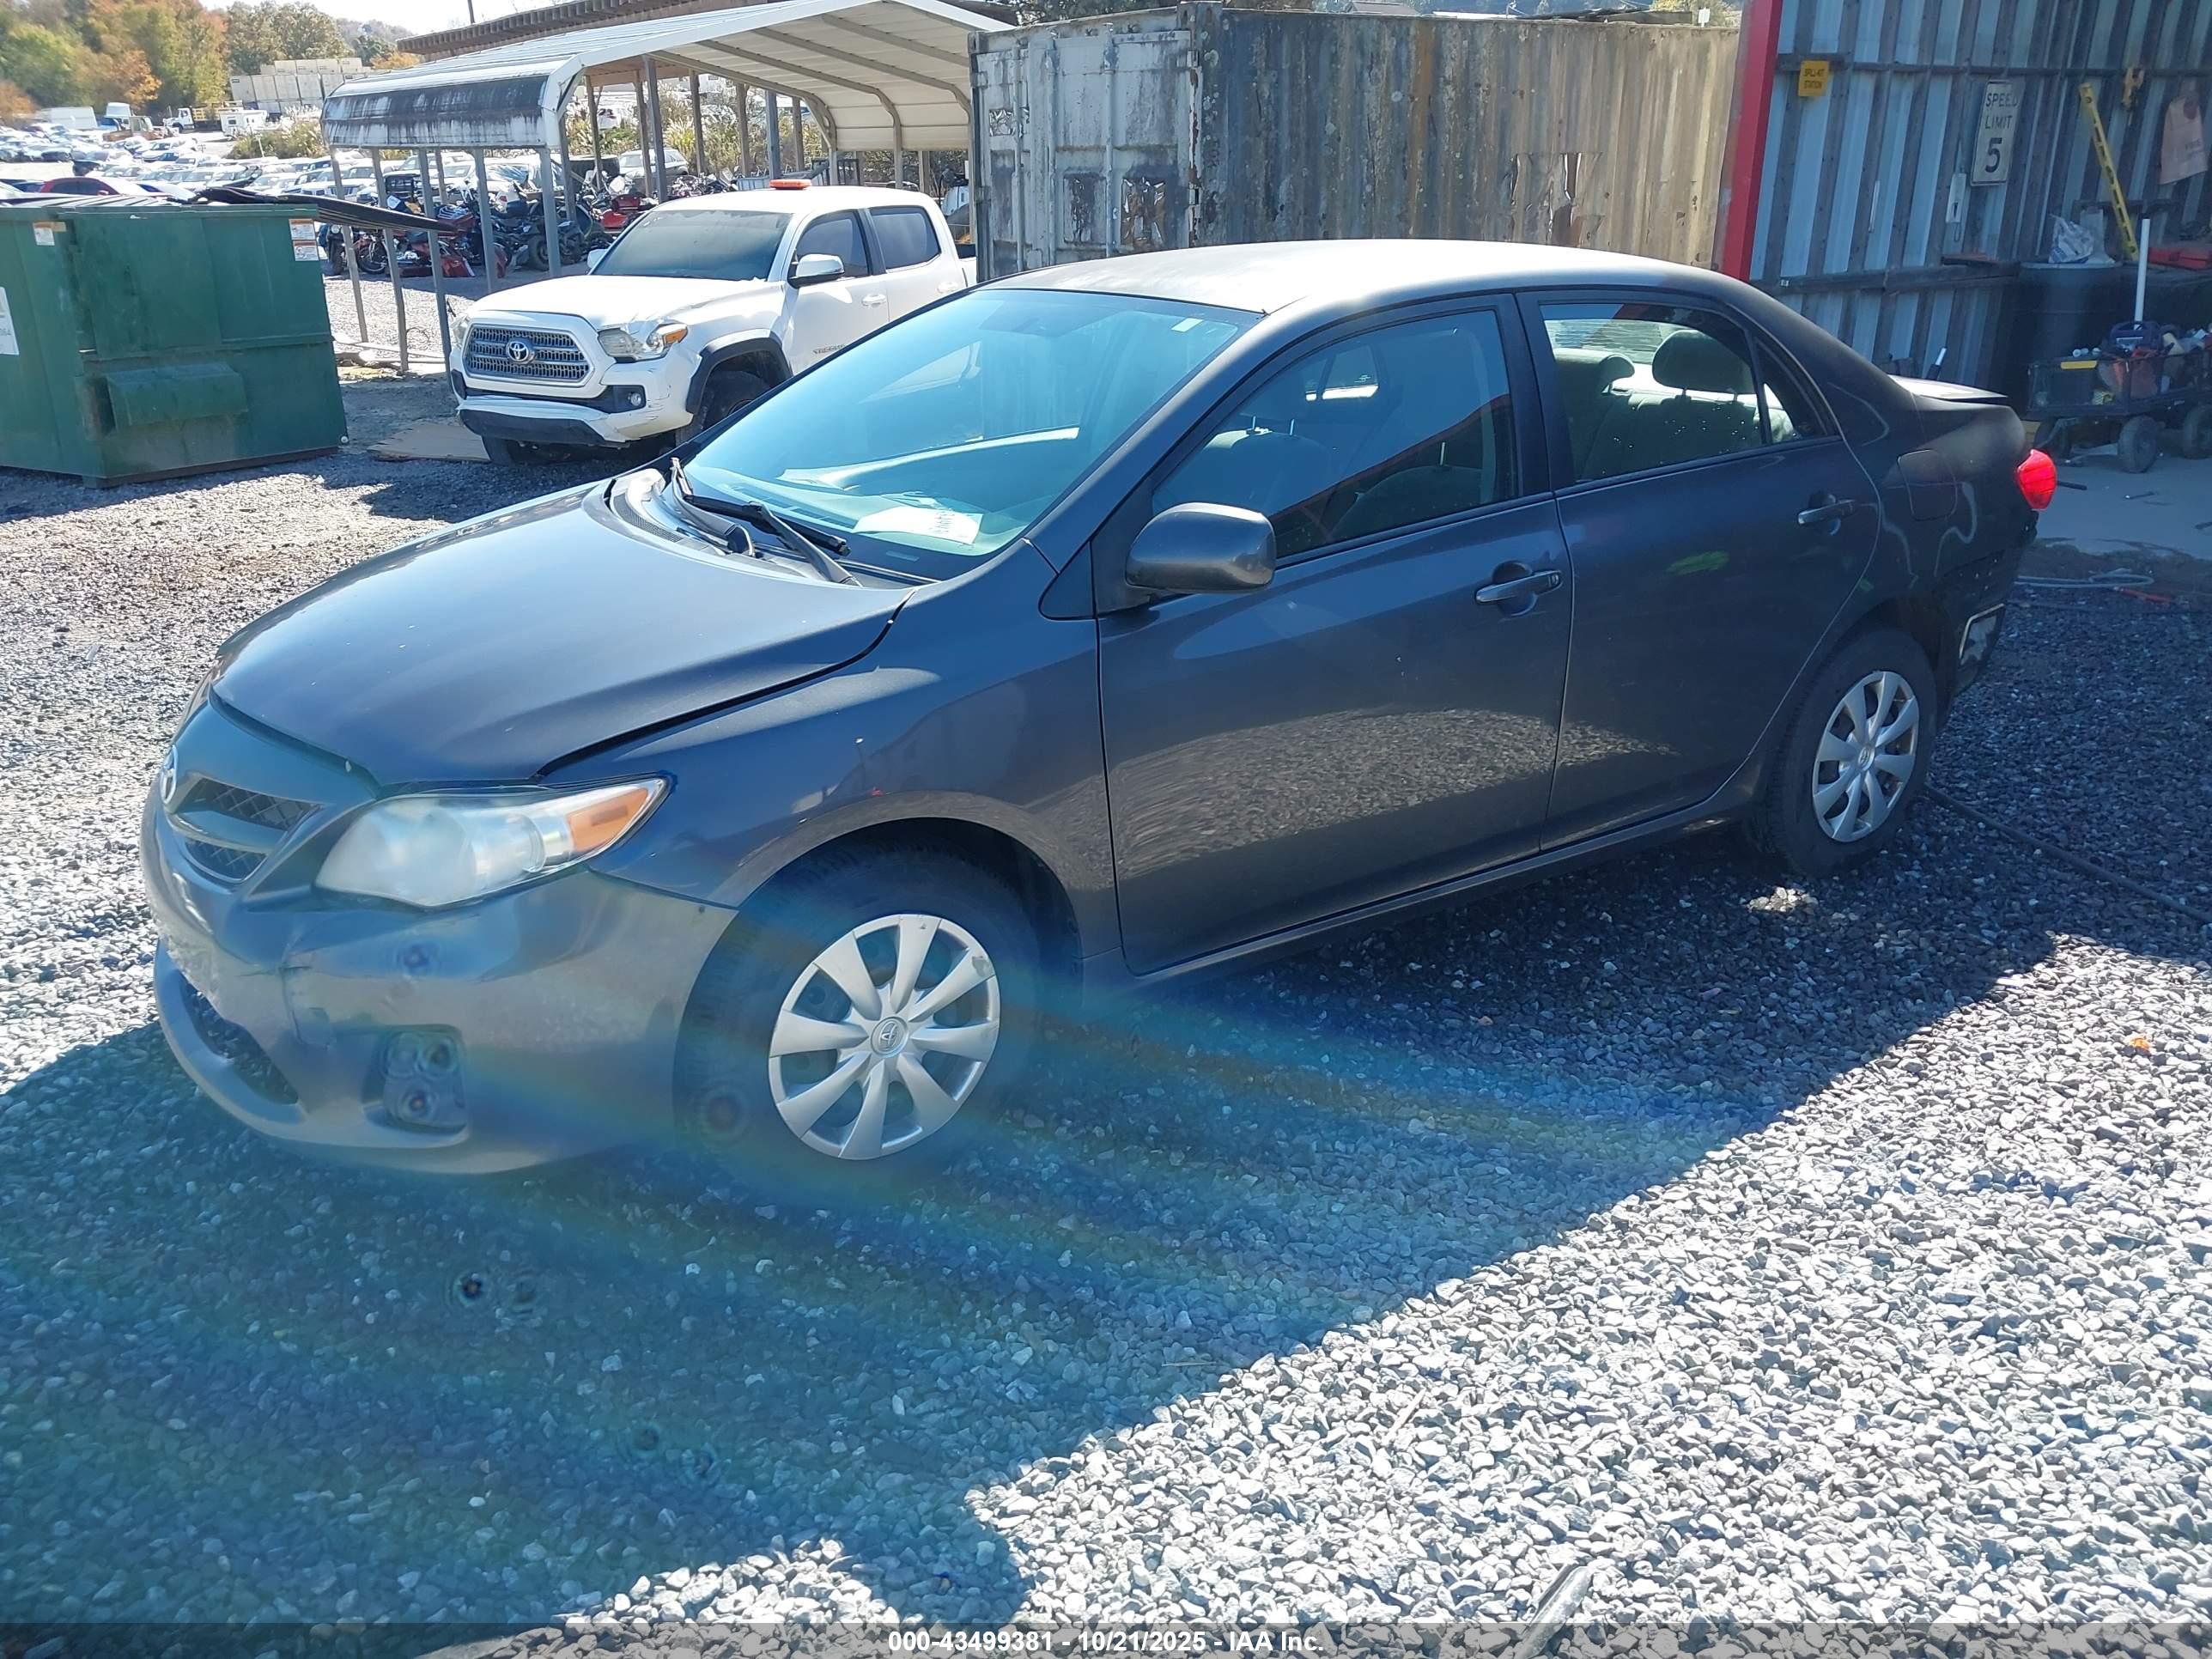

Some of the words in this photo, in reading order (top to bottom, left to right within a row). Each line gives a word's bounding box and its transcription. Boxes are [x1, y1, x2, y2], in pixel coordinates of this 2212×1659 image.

[1985, 92, 2020, 107] SPEED
[1984, 115, 2013, 129] LIMIT
[1985, 137, 2002, 173] 5
